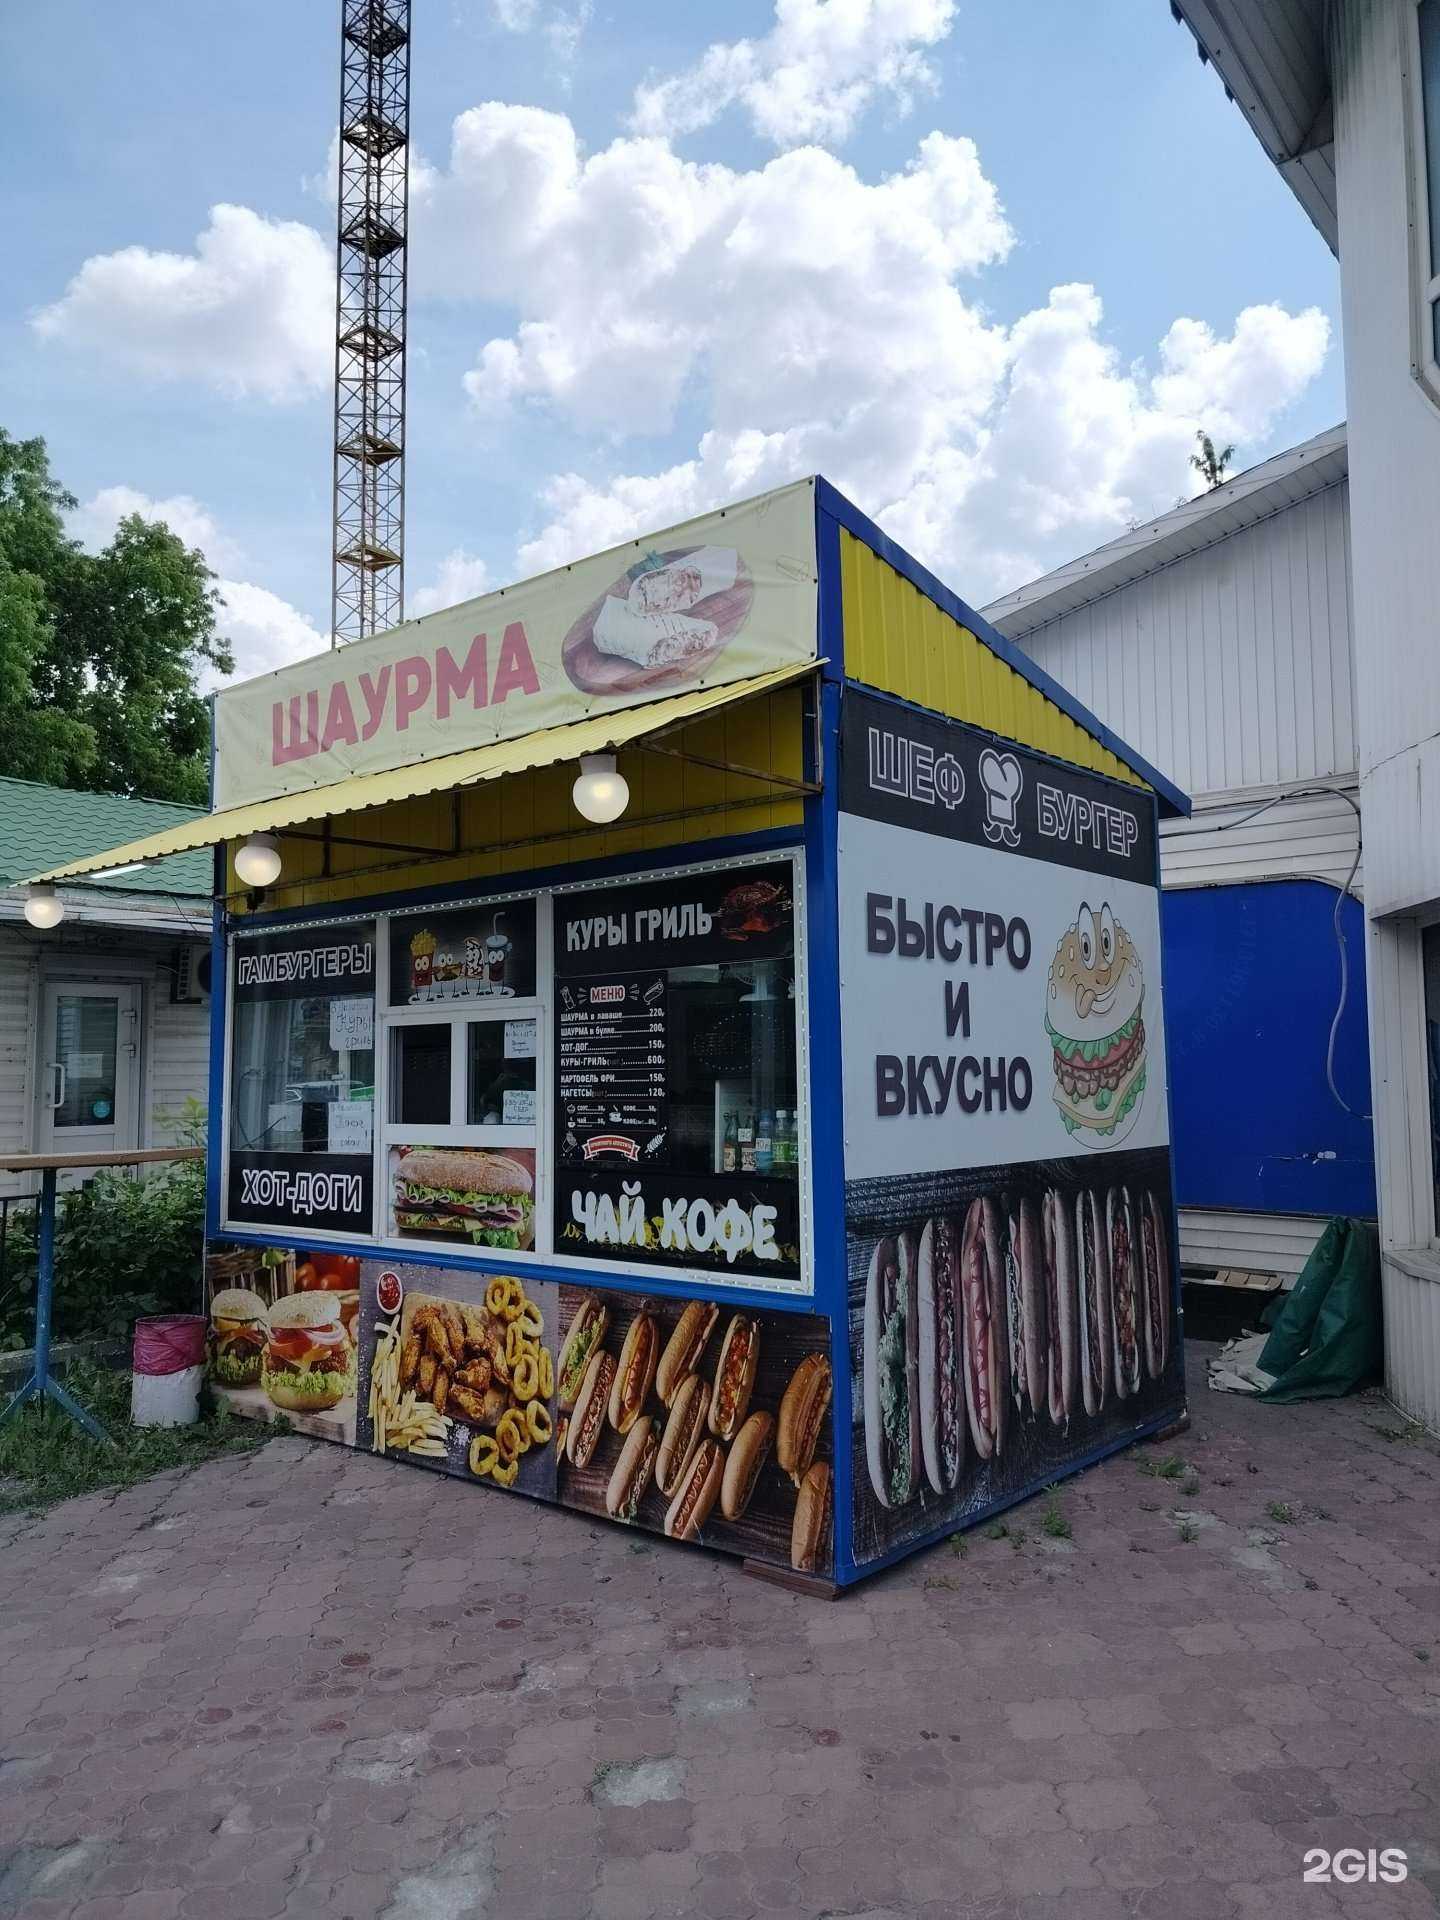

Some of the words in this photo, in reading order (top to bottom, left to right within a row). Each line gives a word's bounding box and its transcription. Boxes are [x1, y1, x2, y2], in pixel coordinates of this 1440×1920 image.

[272, 621, 541, 767] ШАУРМА
[867, 726, 966, 810] ШЕФ
[1036, 781, 1139, 858] БУРГЕР
[566, 913, 628, 952] КУРЫ
[635, 902, 713, 943] ГРИЛЬ
[866, 891, 1032, 971] БЫСТРО
[238, 942, 373, 985] ГАМБУРГЕРЫ
[560, 1012, 588, 1022] ШАУРМА
[591, 986, 624, 1002] МЕНЮ
[944, 979, 971, 1038] И
[560, 1027, 588, 1037] ШАУРМА
[560, 1042, 589, 1053] ХОТ-ДОГ
[560, 1074, 599, 1083] КАРТОФЕЛЬ
[600, 1073, 615, 1082] ФРИ
[874, 1053, 1034, 1119] ВКУСНО
[240, 1169, 363, 1215] ХОТ-ДОГИ
[571, 1180, 646, 1247] ЧАЙ
[660, 1197, 780, 1264] КОФЕ
